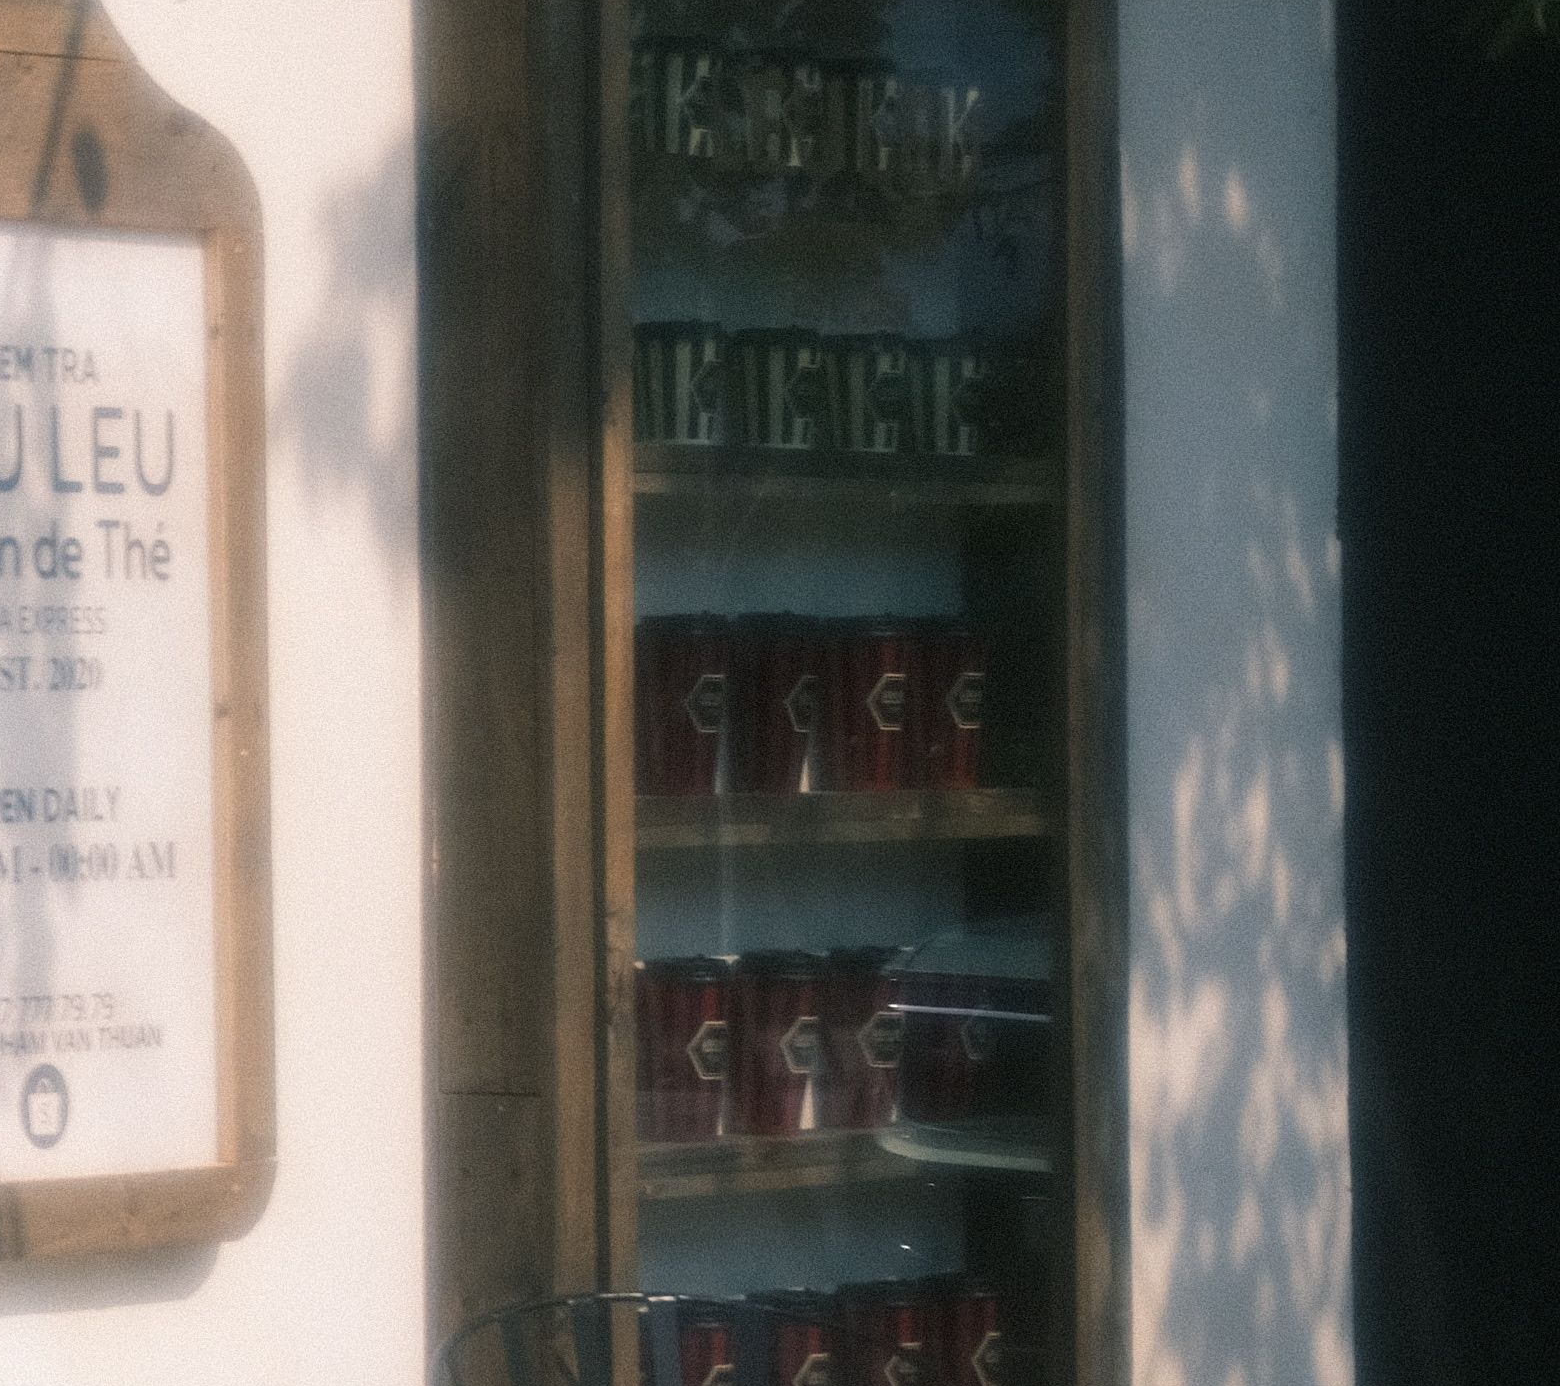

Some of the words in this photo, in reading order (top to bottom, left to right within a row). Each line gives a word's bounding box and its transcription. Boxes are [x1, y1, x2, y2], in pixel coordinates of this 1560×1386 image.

[51, 405, 174, 497] LEU
[34, 521, 84, 581] de
[96, 520, 172, 581] Thé
[42, 786, 122, 823] DAILY
[131, 840, 177, 880] AM
